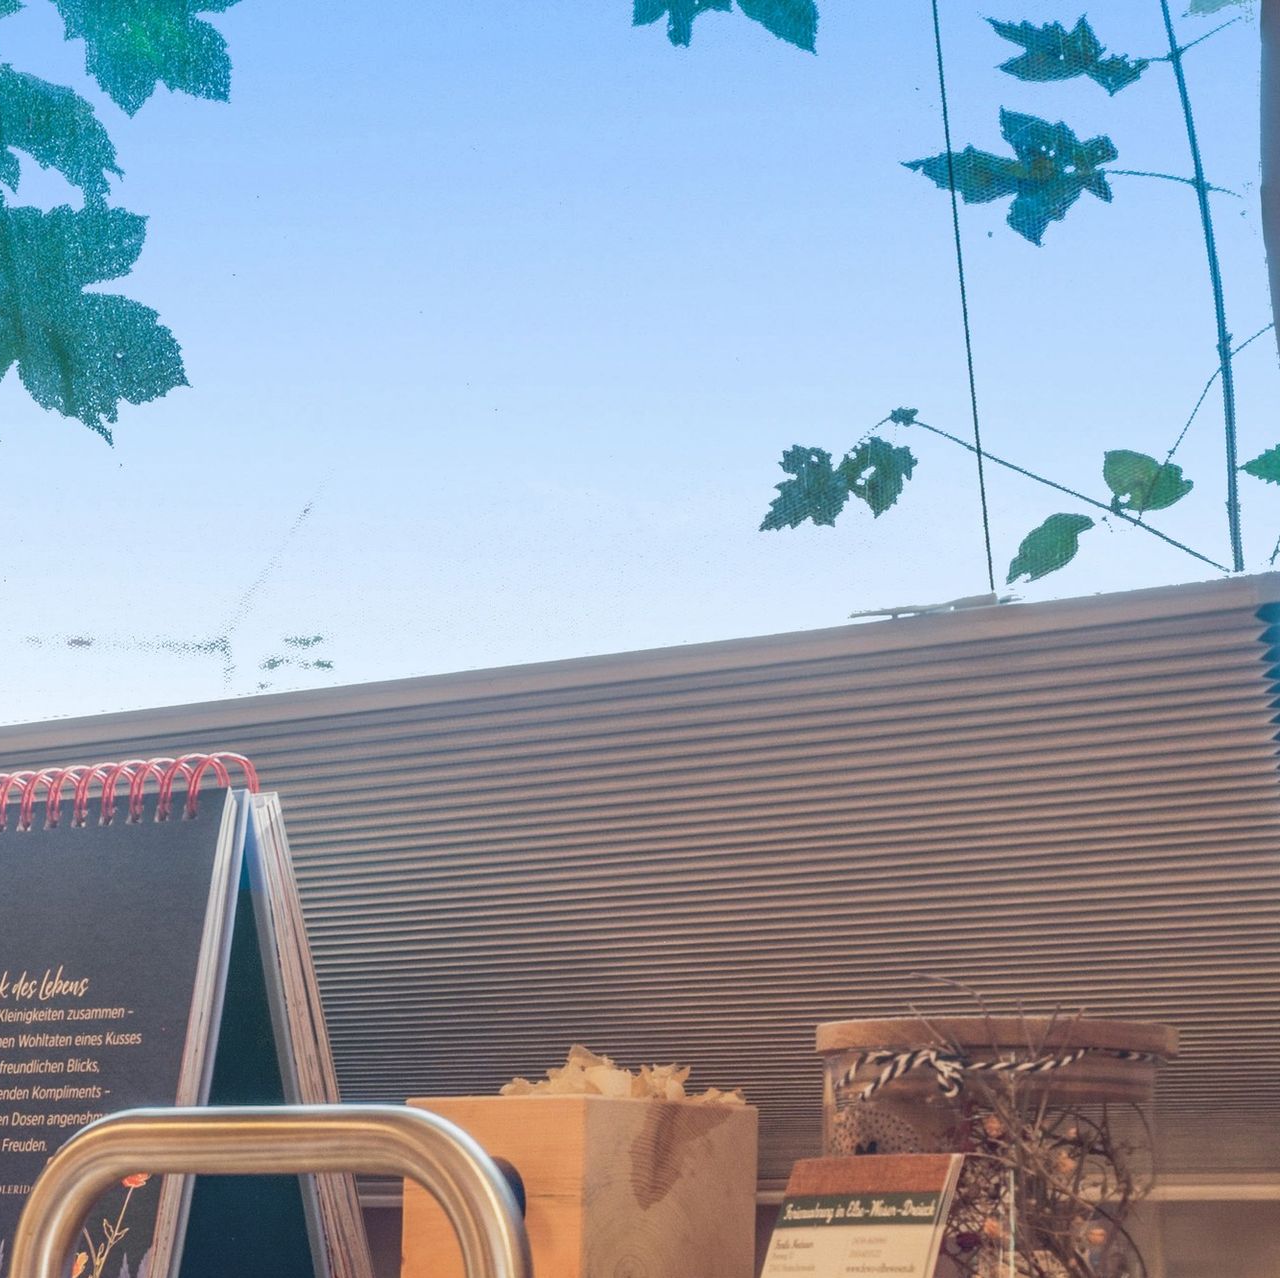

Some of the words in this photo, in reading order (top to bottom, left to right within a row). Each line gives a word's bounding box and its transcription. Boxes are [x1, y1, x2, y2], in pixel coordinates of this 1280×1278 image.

[11, 969, 38, 1001] des
[39, 965, 90, 1000] Lebens
[67, 1008, 125, 1021] zusammen
[18, 1033, 72, 1048] Wohltaten
[74, 1033, 103, 1046] eines
[105, 1031, 142, 1046] Kusses
[0, 1059, 65, 1075] freundlichen
[67, 1059, 100, 1074] Blicks,
[32, 1085, 102, 1101] Kompliments
[12, 1113, 45, 1126] Dosen
[1, 1138, 48, 1152] Freuden.
